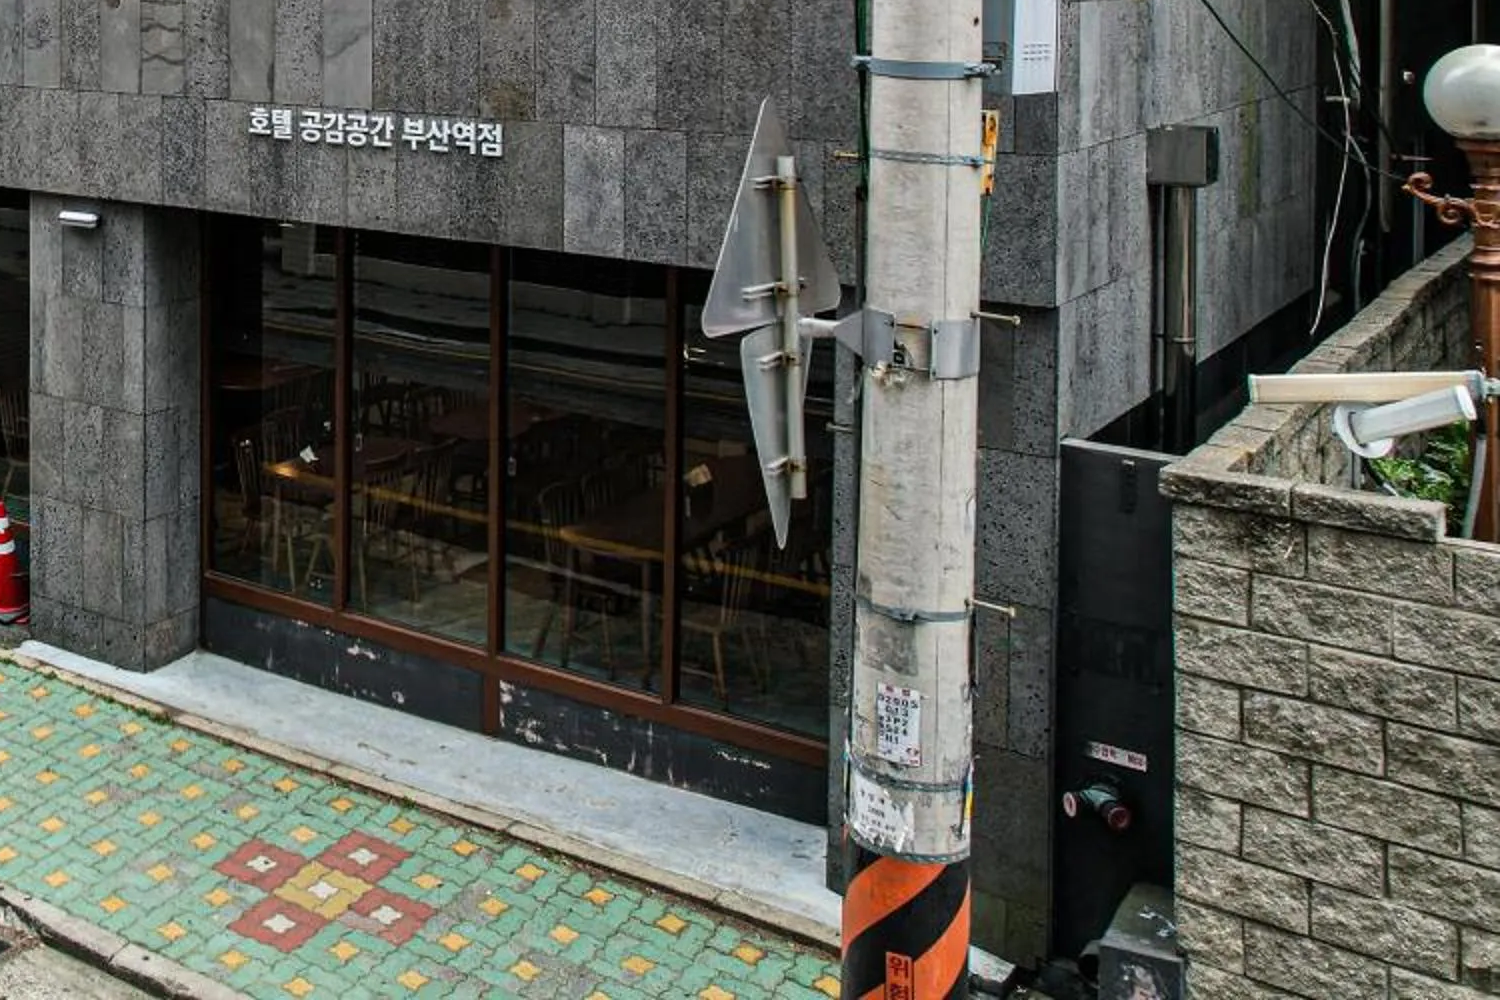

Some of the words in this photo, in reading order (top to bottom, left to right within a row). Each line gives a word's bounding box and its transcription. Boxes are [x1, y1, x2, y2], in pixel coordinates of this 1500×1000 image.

[248, 107, 293, 140] 호텔
[299, 110, 395, 148] 공감공간
[401, 117, 503, 158] 부산역점
